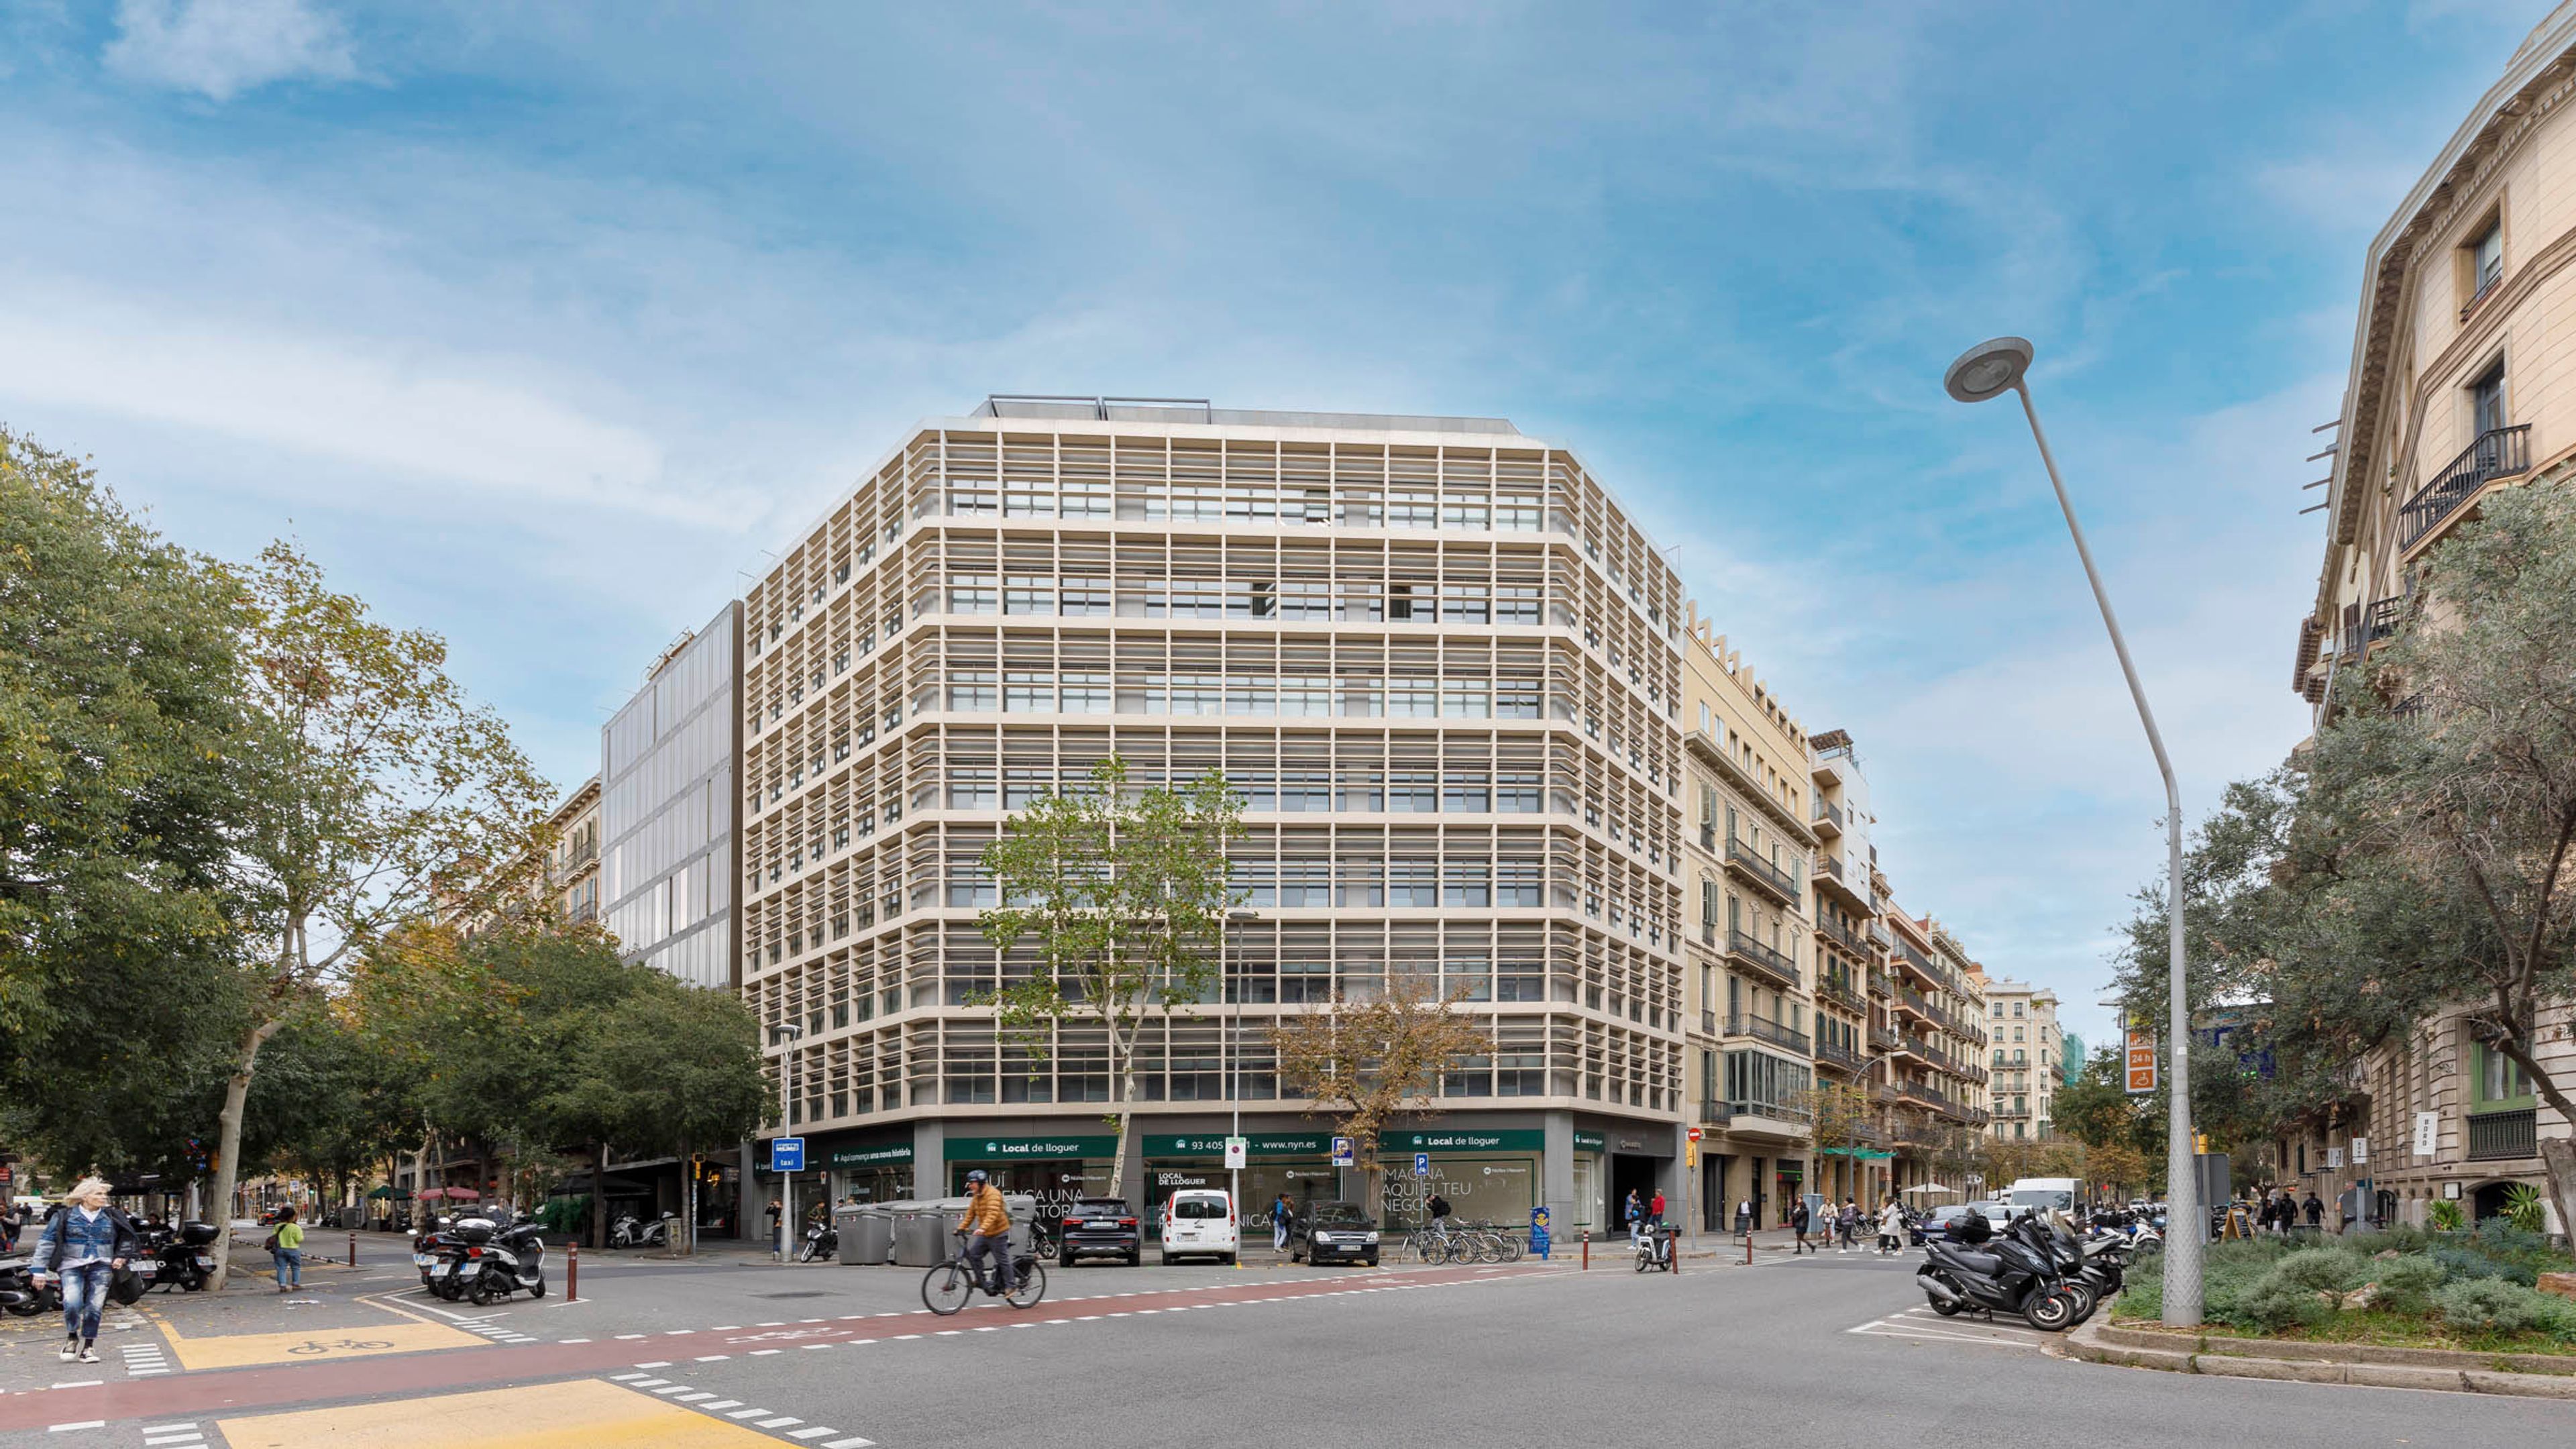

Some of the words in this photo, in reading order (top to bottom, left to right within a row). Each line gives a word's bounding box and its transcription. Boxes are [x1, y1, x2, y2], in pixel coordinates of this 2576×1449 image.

[2132, 1054, 2142, 1063] 24
[2145, 1053, 2151, 1063] h
[1191, 1142, 1203, 1150] 93
[1205, 1142, 1224, 1150] 405
[1262, 1141, 1316, 1150] www.nyn.es
[1428, 1137, 1453, 1145] Local
[1455, 1137, 1466, 1145] de
[1468, 1137, 1500, 1146] lloguer
[1002, 1144, 1028, 1152] Local
[1032, 1144, 1043, 1152] de
[1046, 1143, 1079, 1153] lloguer
[1441, 1183, 1471, 1195] TEU
[1239, 1214, 1271, 1227] NICA
